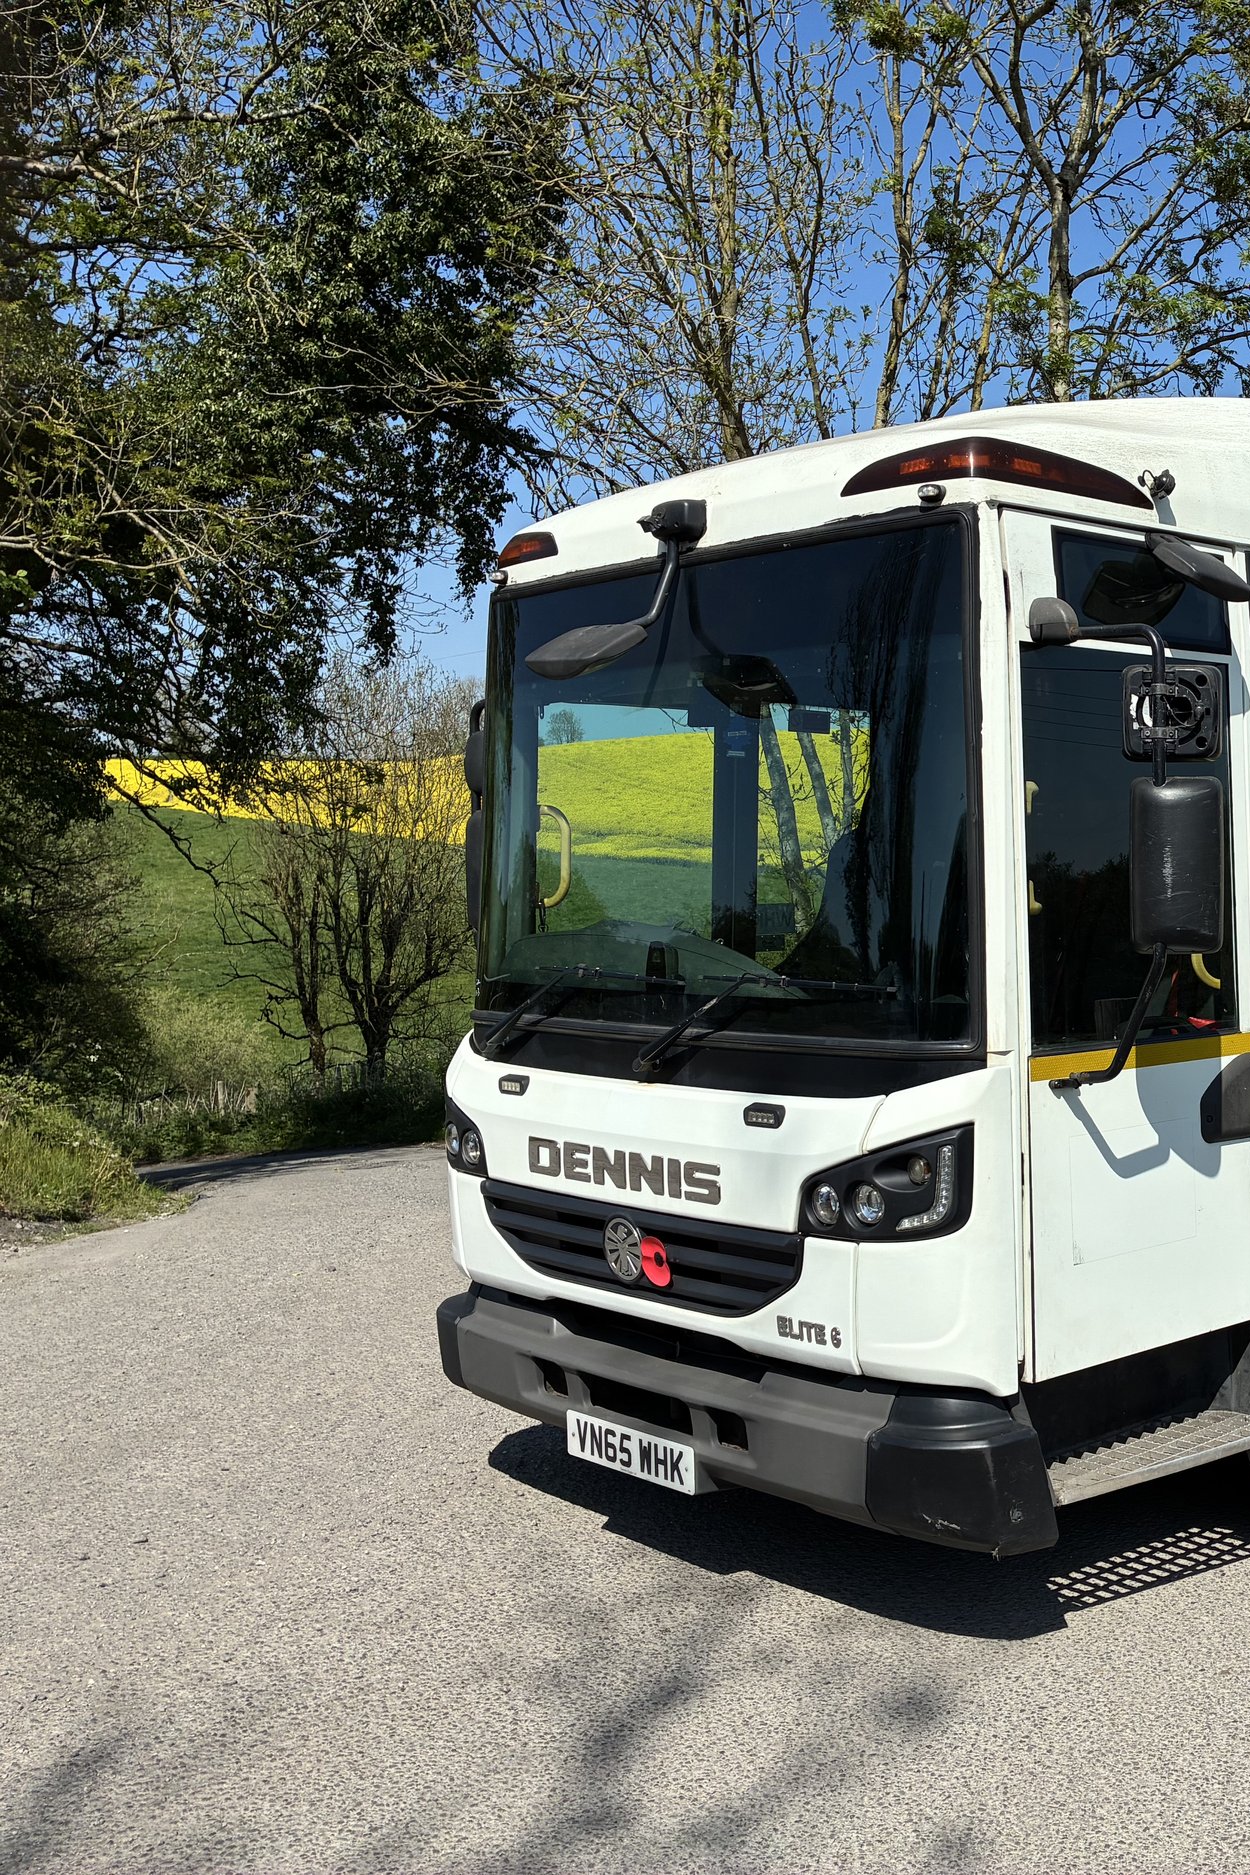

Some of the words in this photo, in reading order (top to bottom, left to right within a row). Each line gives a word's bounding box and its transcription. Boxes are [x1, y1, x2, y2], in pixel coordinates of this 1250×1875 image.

[528, 1135, 722, 1206] DENNIS
[776, 1315, 828, 1346] ELITE
[830, 1326, 842, 1349] 6
[576, 1418, 632, 1468] VN65
[638, 1438, 685, 1486] WHK
